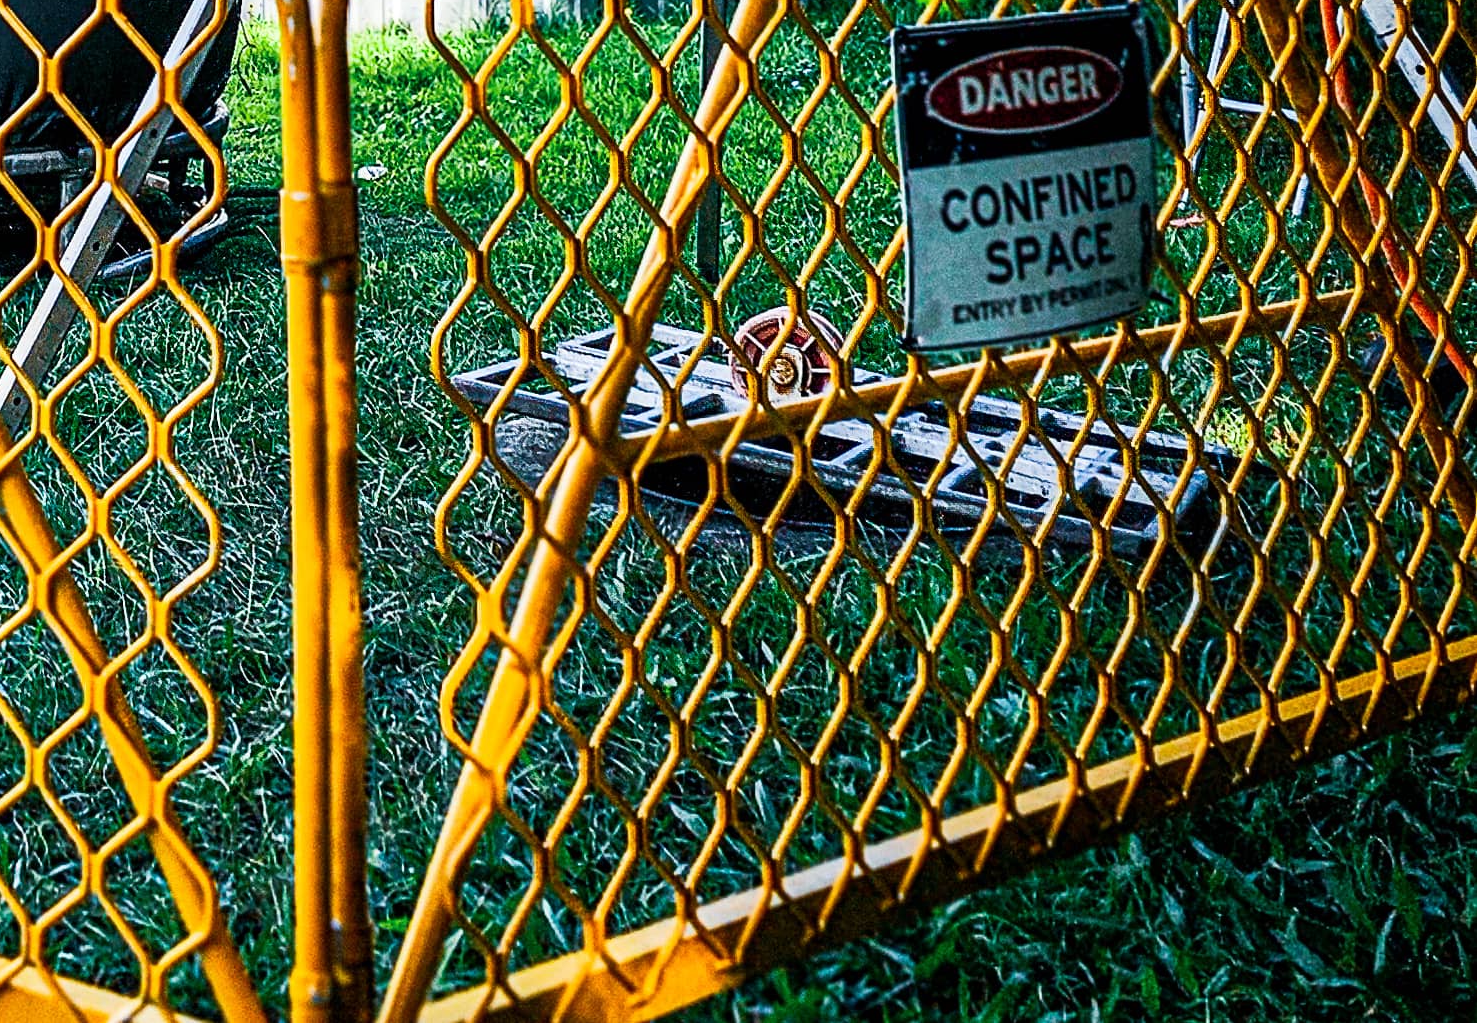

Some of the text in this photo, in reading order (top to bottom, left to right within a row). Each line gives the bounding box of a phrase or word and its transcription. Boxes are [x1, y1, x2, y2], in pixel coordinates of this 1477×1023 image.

[958, 63, 1101, 116] DANGER
[941, 164, 1137, 234] CONFINED
[986, 224, 1115, 284] SPACE
[952, 298, 1016, 325] ENTRY
[1020, 293, 1043, 314] BY
